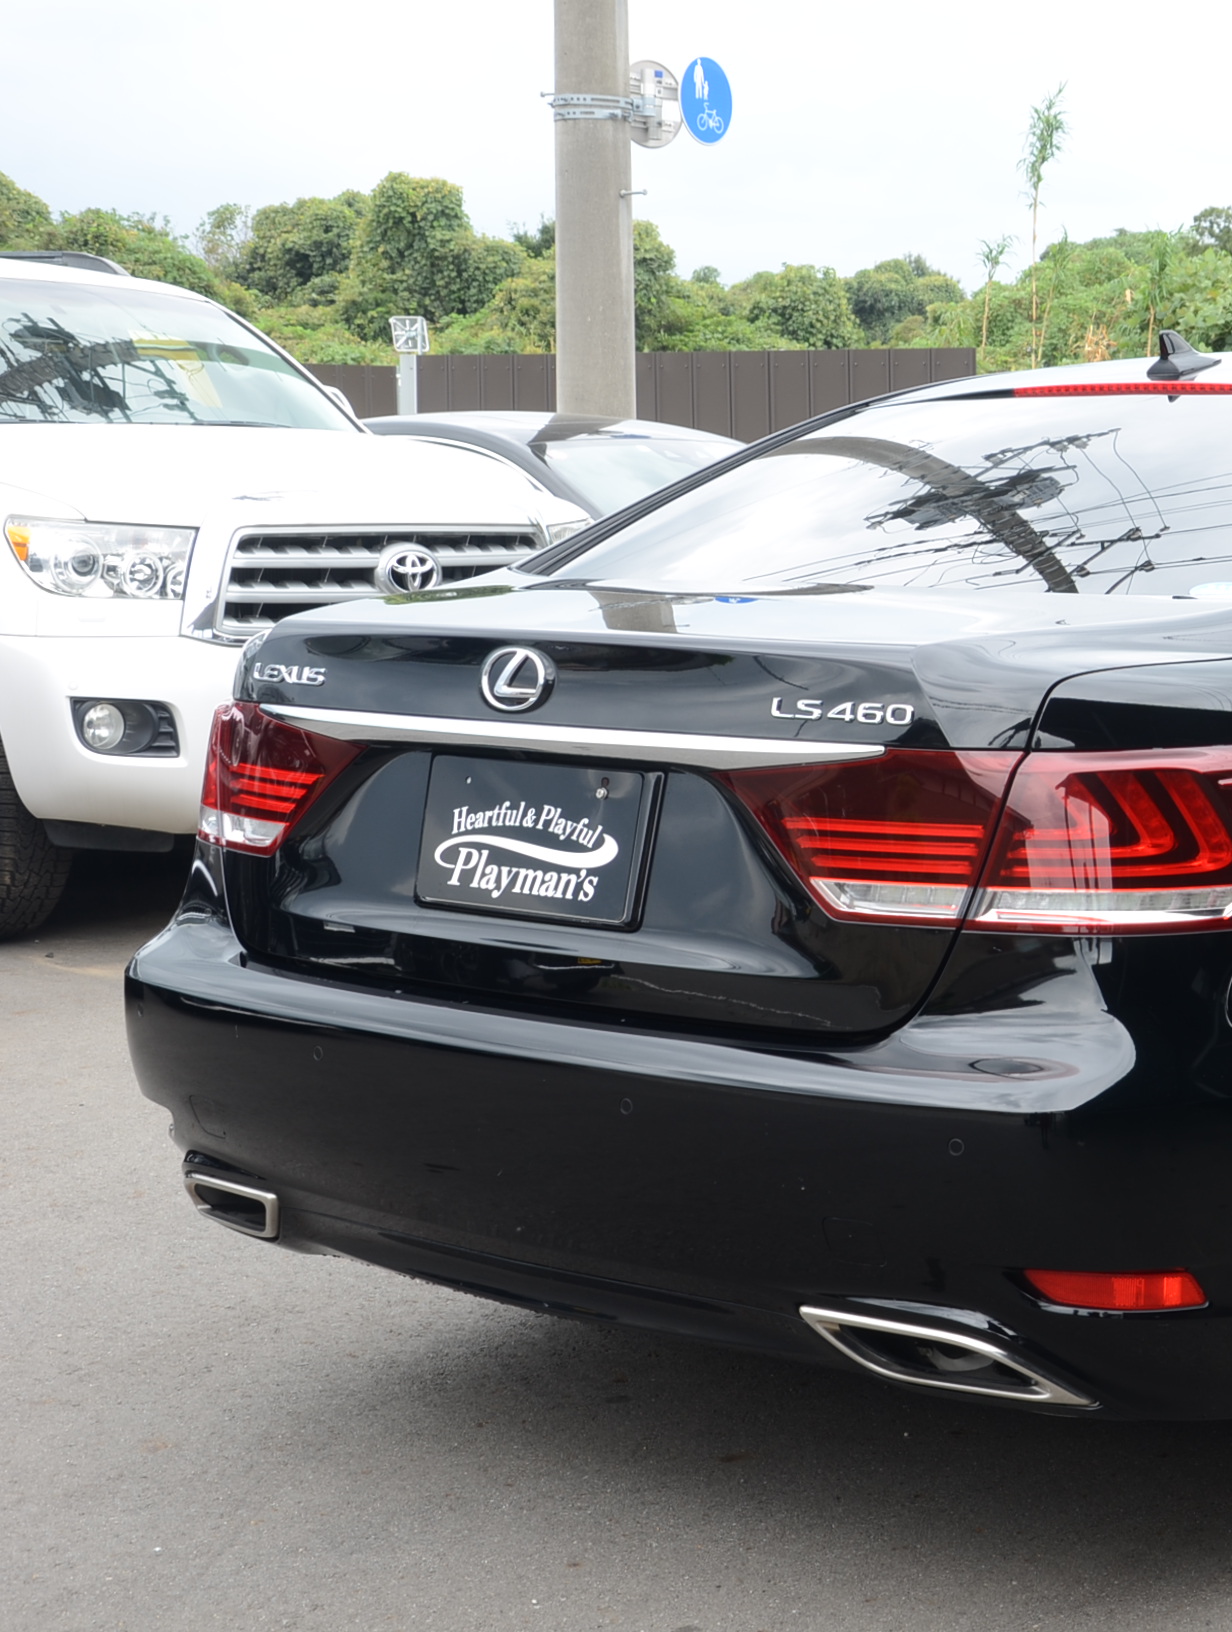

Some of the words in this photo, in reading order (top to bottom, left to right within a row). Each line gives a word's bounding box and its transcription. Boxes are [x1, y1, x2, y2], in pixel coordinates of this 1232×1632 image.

[253, 662, 326, 686] LEXUS
[451, 801, 526, 835] Heartful
[522, 807, 537, 828] &
[535, 804, 603, 848] Playful
[447, 847, 599, 902] Playman's
